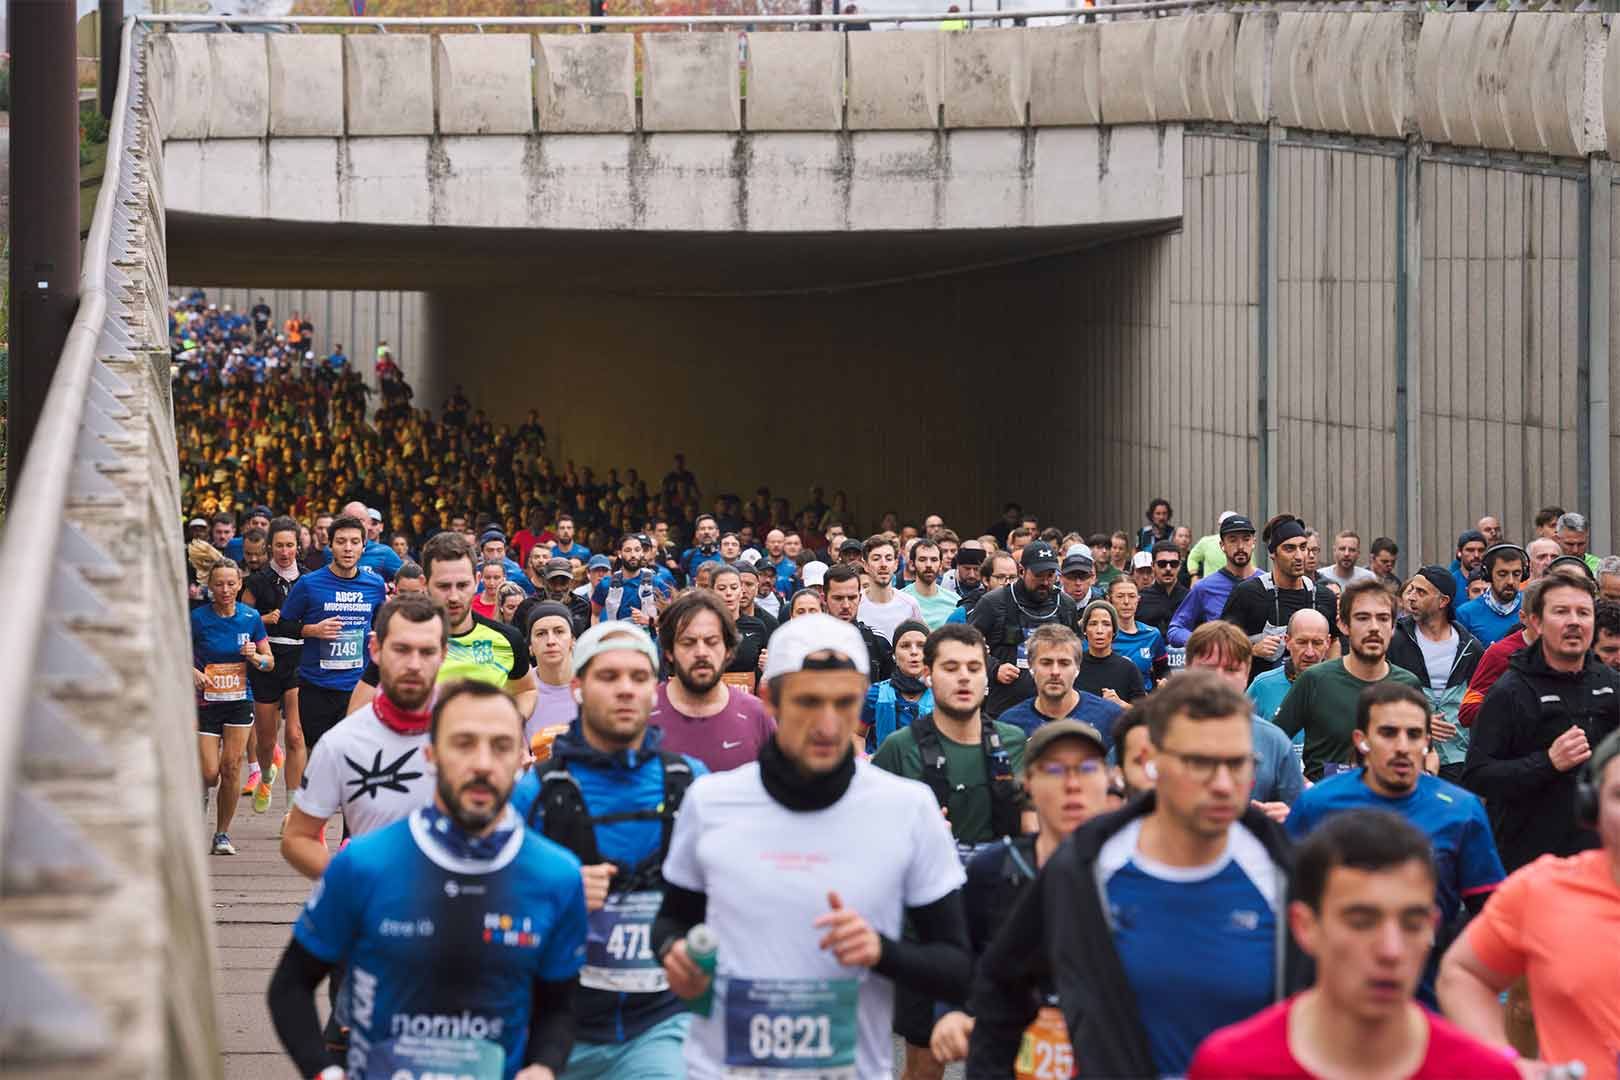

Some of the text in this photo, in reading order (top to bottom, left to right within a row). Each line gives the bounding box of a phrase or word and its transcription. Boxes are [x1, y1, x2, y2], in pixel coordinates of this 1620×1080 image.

[329, 641, 357, 657] 7149
[213, 674, 240, 689] 3104
[606, 923, 654, 960] 471
[751, 1013, 833, 1059] 6821
